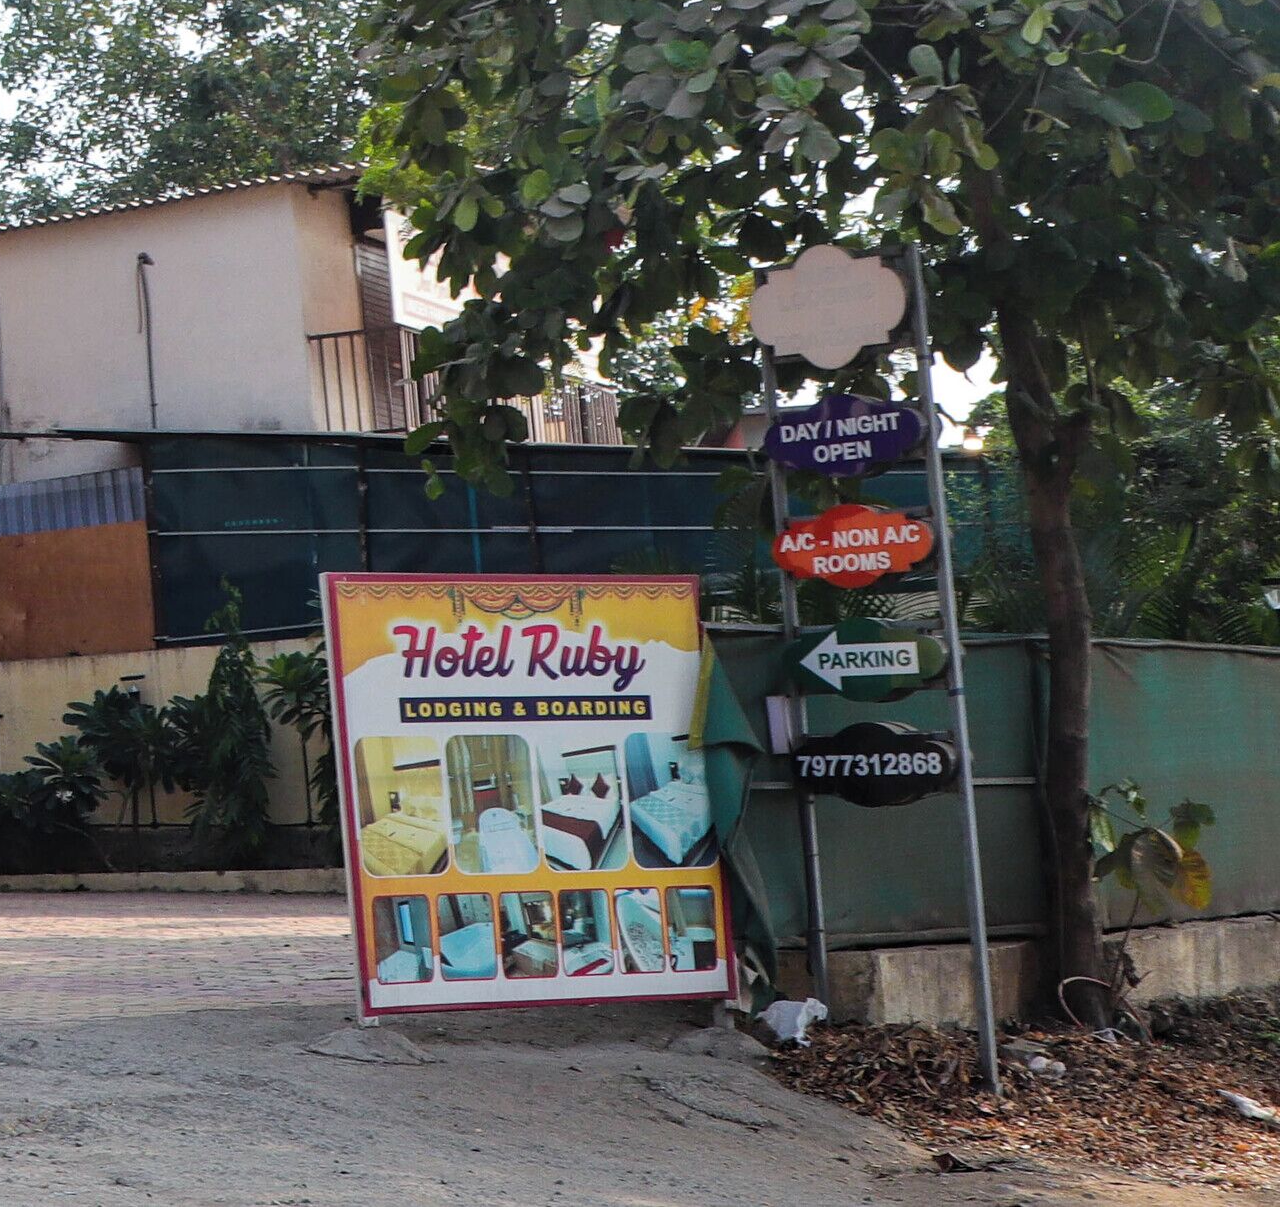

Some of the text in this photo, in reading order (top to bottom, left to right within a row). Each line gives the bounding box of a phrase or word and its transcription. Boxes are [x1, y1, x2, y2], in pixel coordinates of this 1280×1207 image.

[780, 421, 823, 443] DAY
[835, 412, 900, 436] NIGHT
[813, 440, 872, 463] OPEN
[780, 533, 816, 553] A/C
[833, 528, 879, 548] NON
[883, 525, 920, 544] A/C
[813, 552, 891, 574] ROOMS
[393, 625, 646, 692] Hotel Ruby
[818, 649, 911, 670] PARKING
[405, 700, 647, 718] LODGING & BOARDING
[796, 752, 942, 777] 7977312868
